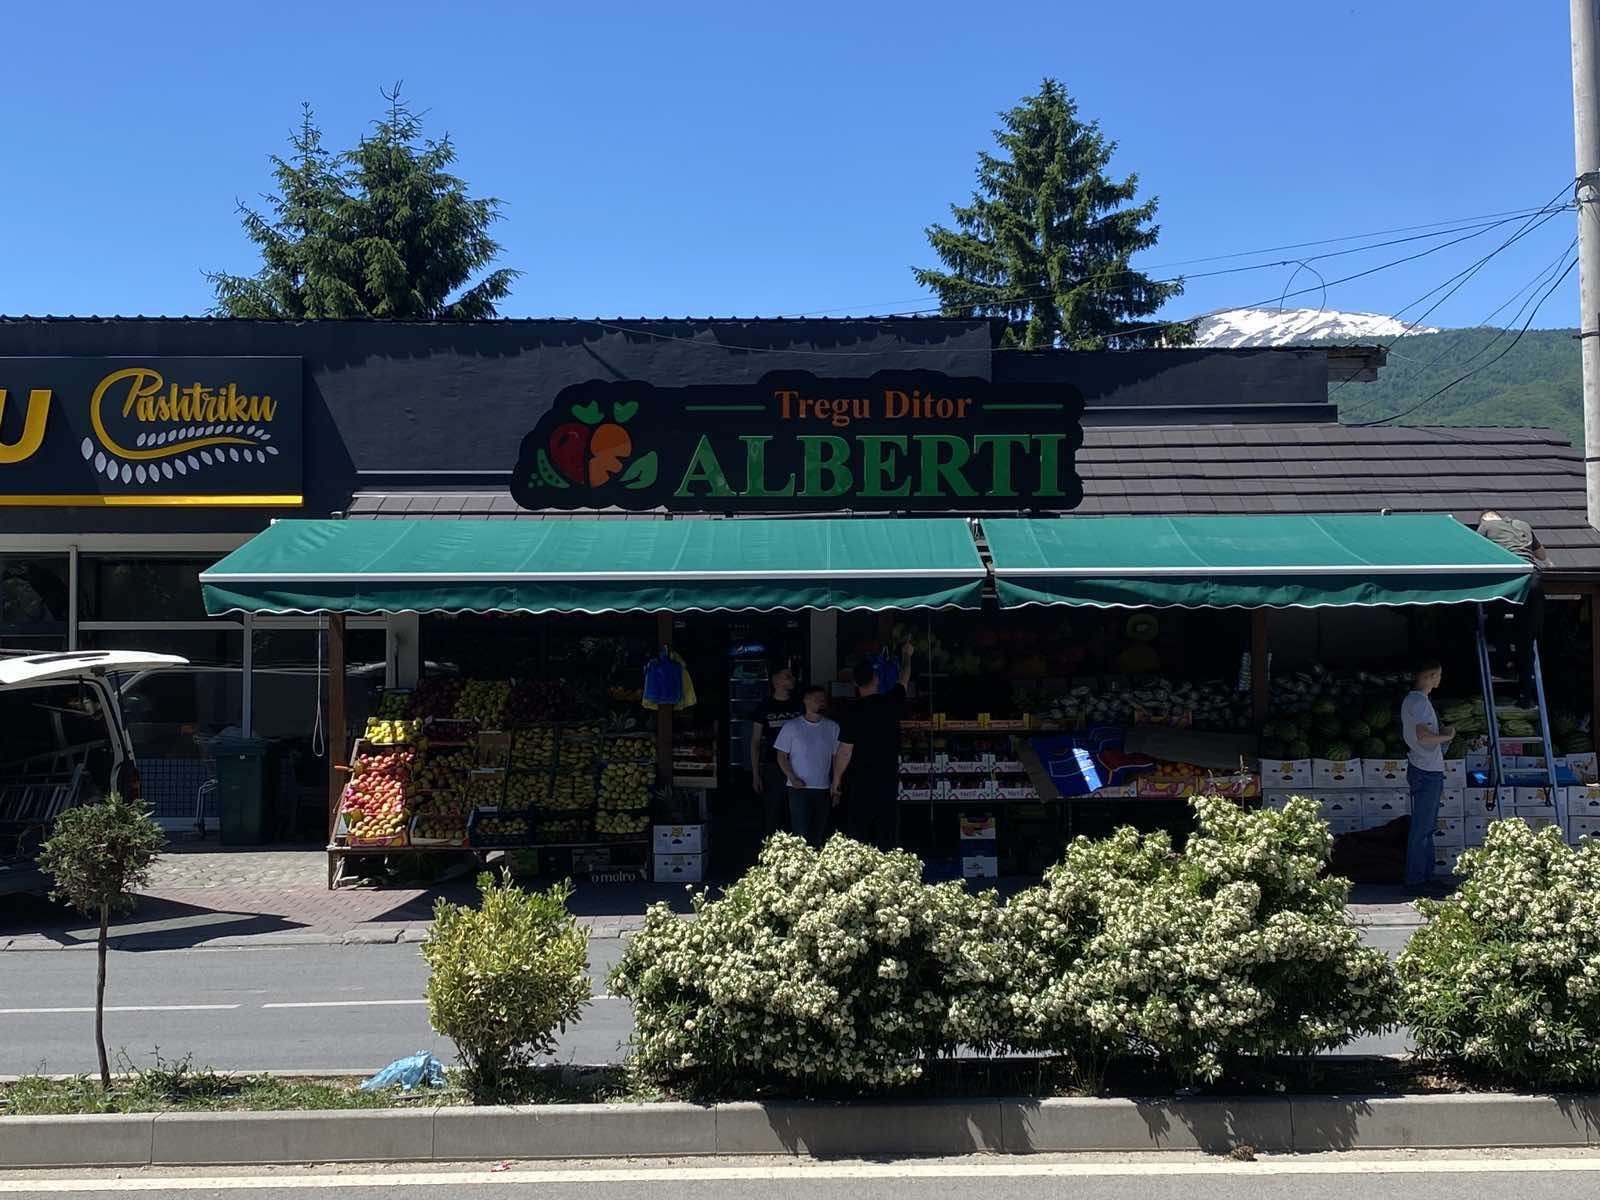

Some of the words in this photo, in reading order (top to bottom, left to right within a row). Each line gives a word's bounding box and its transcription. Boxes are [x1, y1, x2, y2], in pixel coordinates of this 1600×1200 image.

[90, 367, 277, 422] Pashtriku
[774, 390, 872, 426] Tregu
[883, 389, 972, 419] Ditor
[673, 433, 1067, 498] ALBERTI
